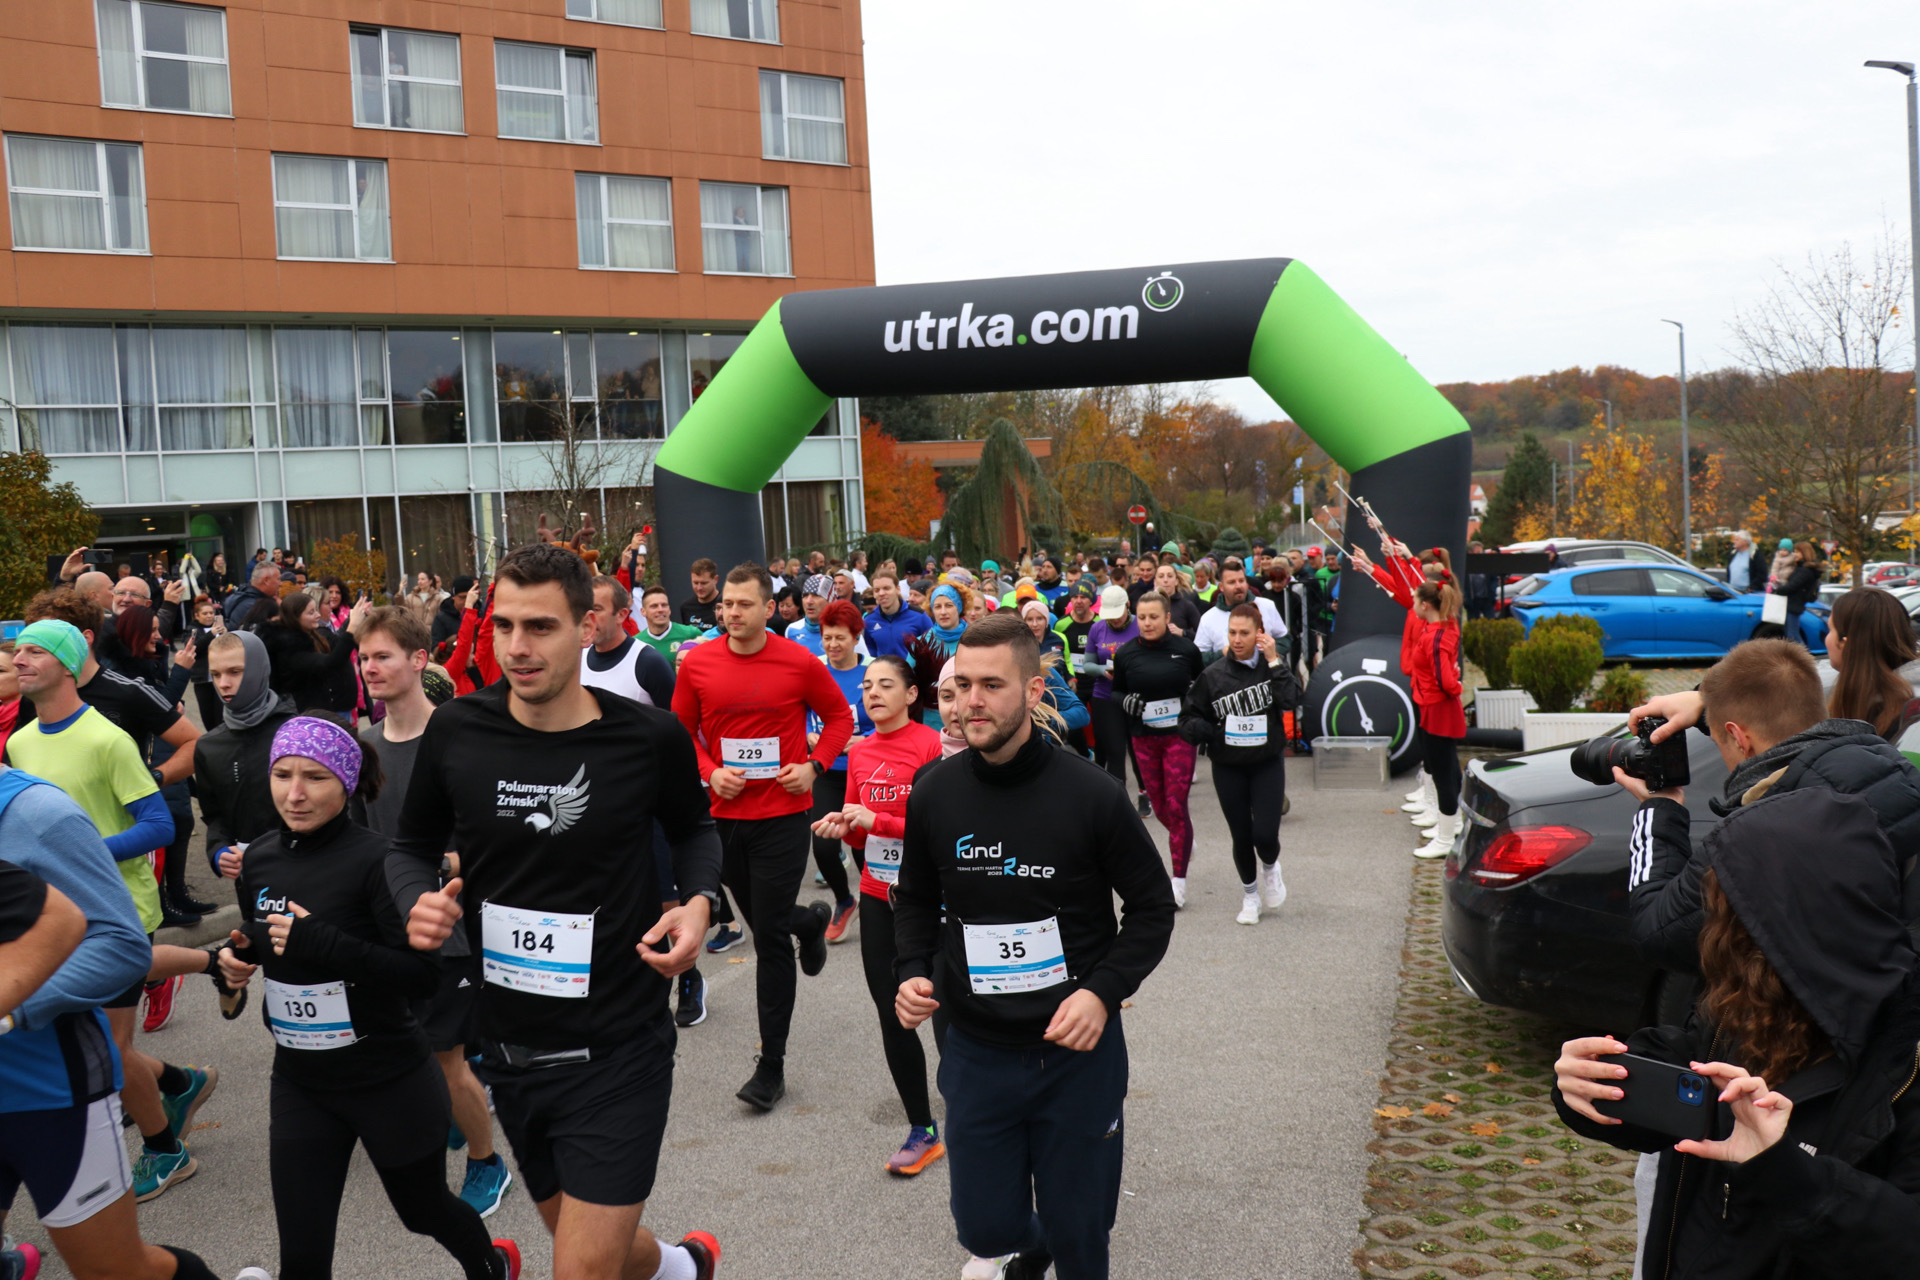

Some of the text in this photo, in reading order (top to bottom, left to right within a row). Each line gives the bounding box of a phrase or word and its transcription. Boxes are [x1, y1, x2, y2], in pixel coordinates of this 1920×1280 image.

[884, 302, 1139, 352] utrka.com
[1154, 707, 1169, 716] 123
[1237, 723, 1254, 732] 182
[738, 749, 762, 759] 229
[497, 780, 577, 796] Polumaraton
[883, 849, 899, 861] 29
[956, 834, 1002, 859] Fund
[1004, 857, 1056, 879] Race
[256, 886, 286, 912] Fund
[512, 929, 554, 954] 184
[999, 941, 1026, 959] 35
[284, 1001, 317, 1018] 130
